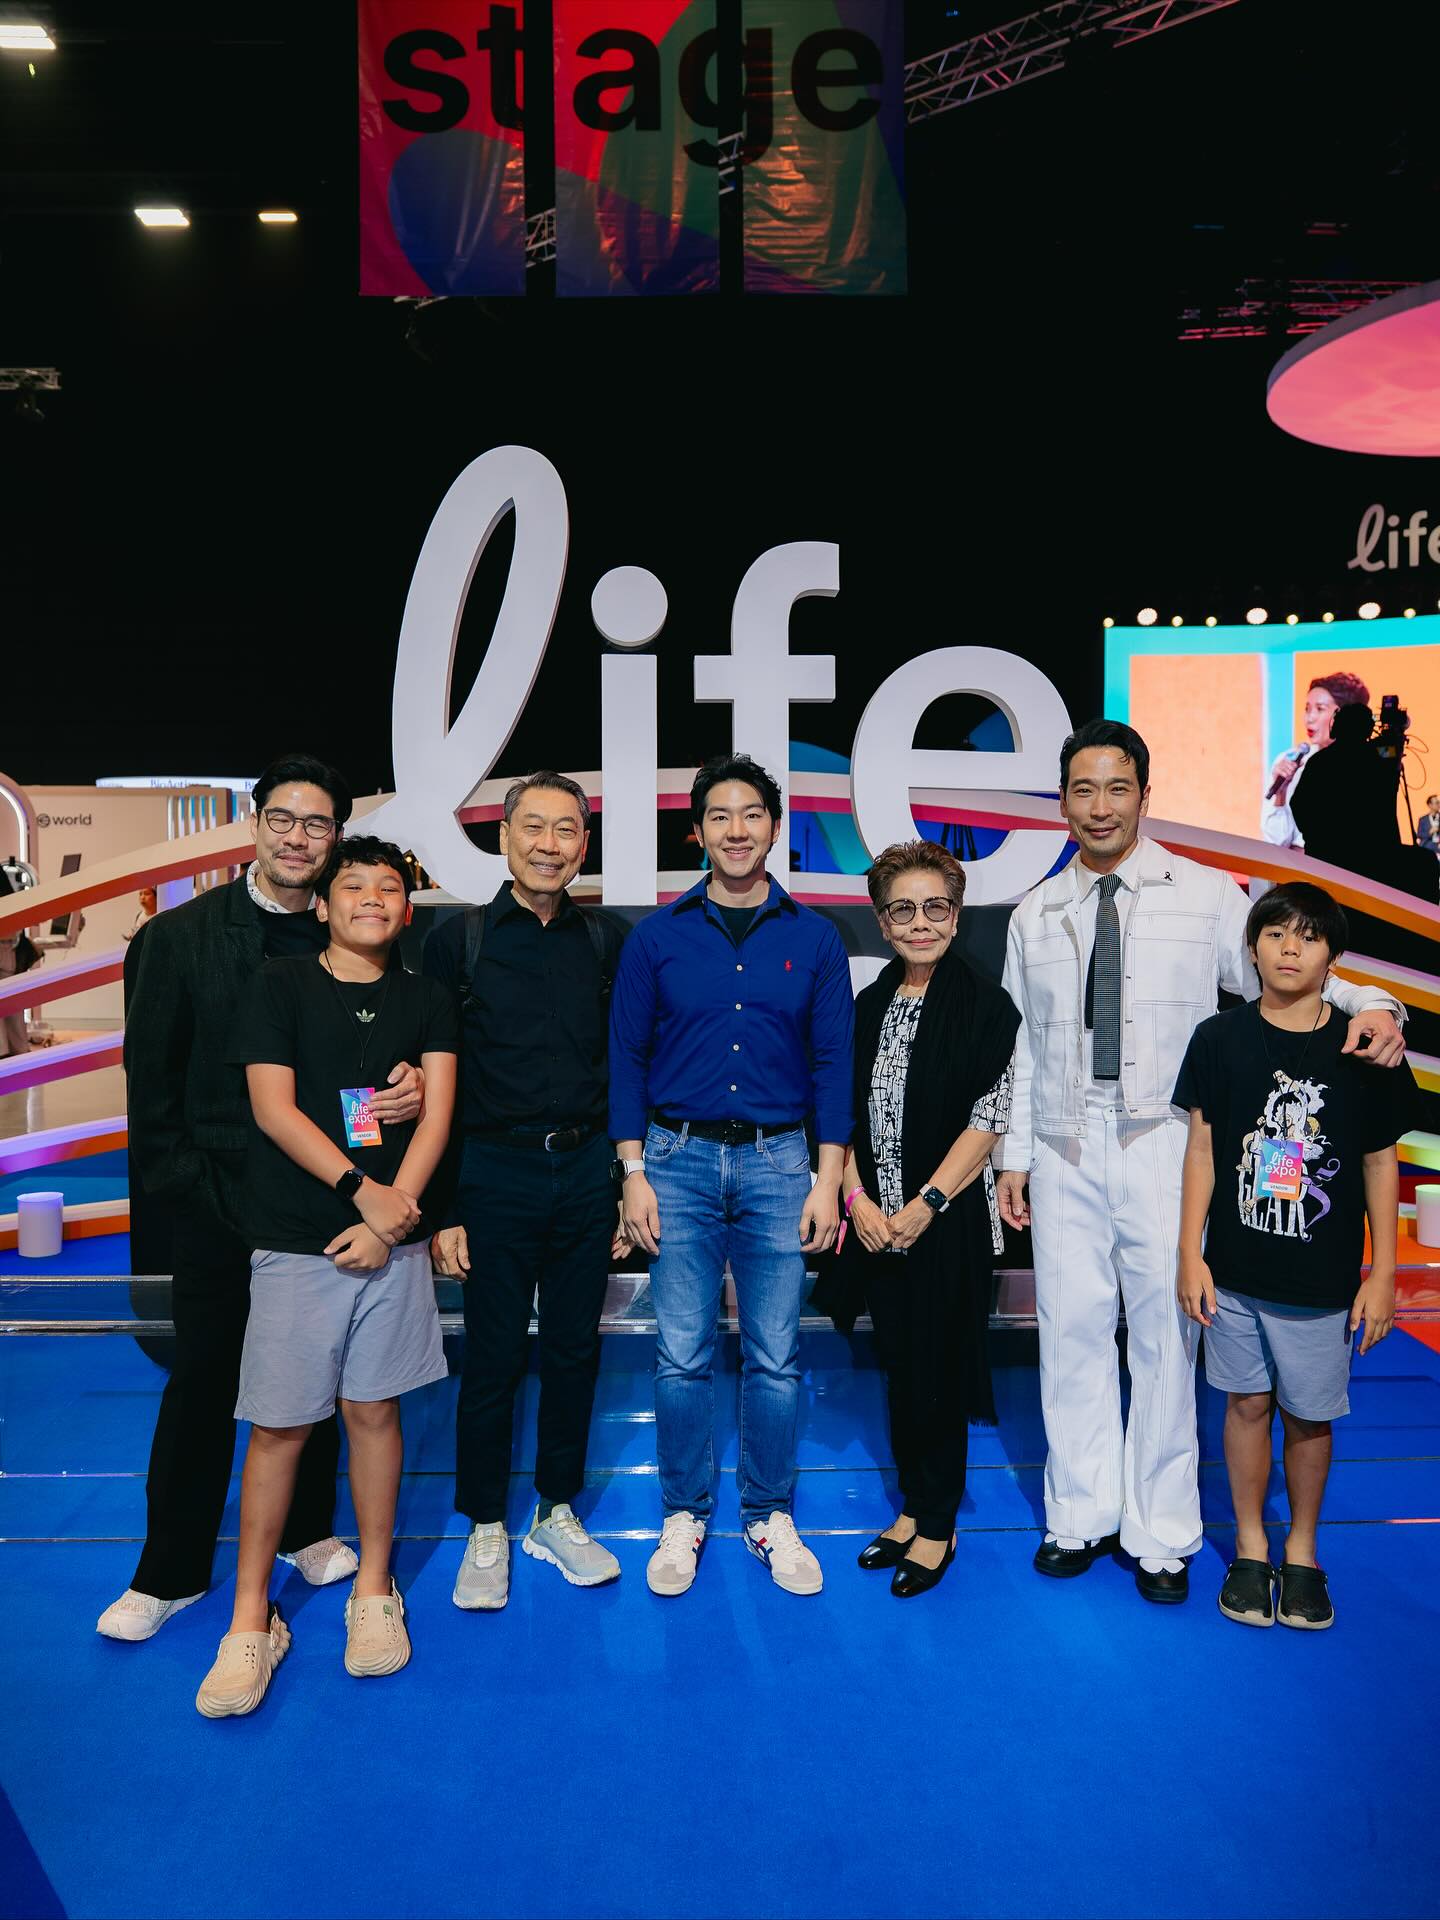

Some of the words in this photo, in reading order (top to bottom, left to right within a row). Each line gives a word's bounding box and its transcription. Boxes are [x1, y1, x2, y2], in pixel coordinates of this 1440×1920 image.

[382, 4, 885, 168] stage
[344, 444, 1074, 906] life
[52, 813, 92, 826] world
[351, 1100, 369, 1115] life
[348, 1113, 374, 1126] expo
[1270, 1151, 1294, 1168] life
[1264, 1164, 1297, 1177] expo
